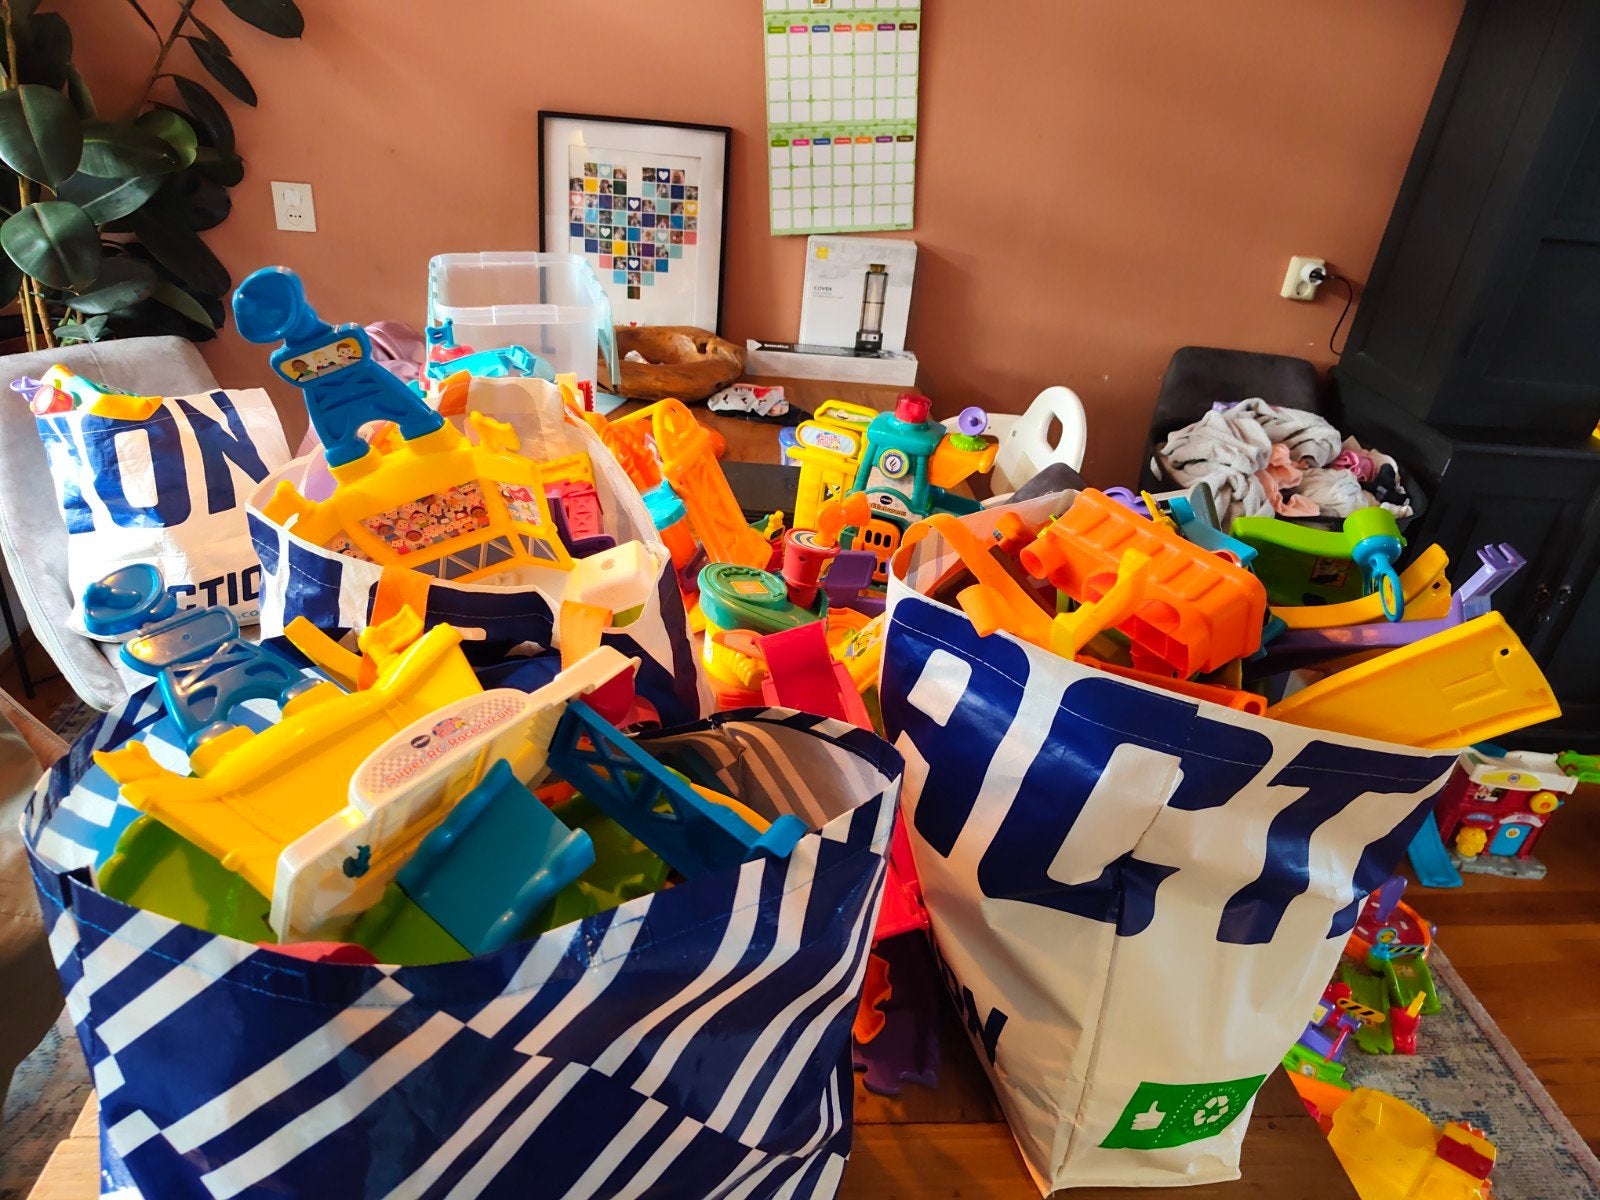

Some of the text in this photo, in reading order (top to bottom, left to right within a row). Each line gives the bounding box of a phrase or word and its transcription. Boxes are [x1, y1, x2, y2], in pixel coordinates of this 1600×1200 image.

[384, 758, 426, 785] Super
[426, 743, 447, 759] RC
[447, 706, 514, 748] Racecircuit
